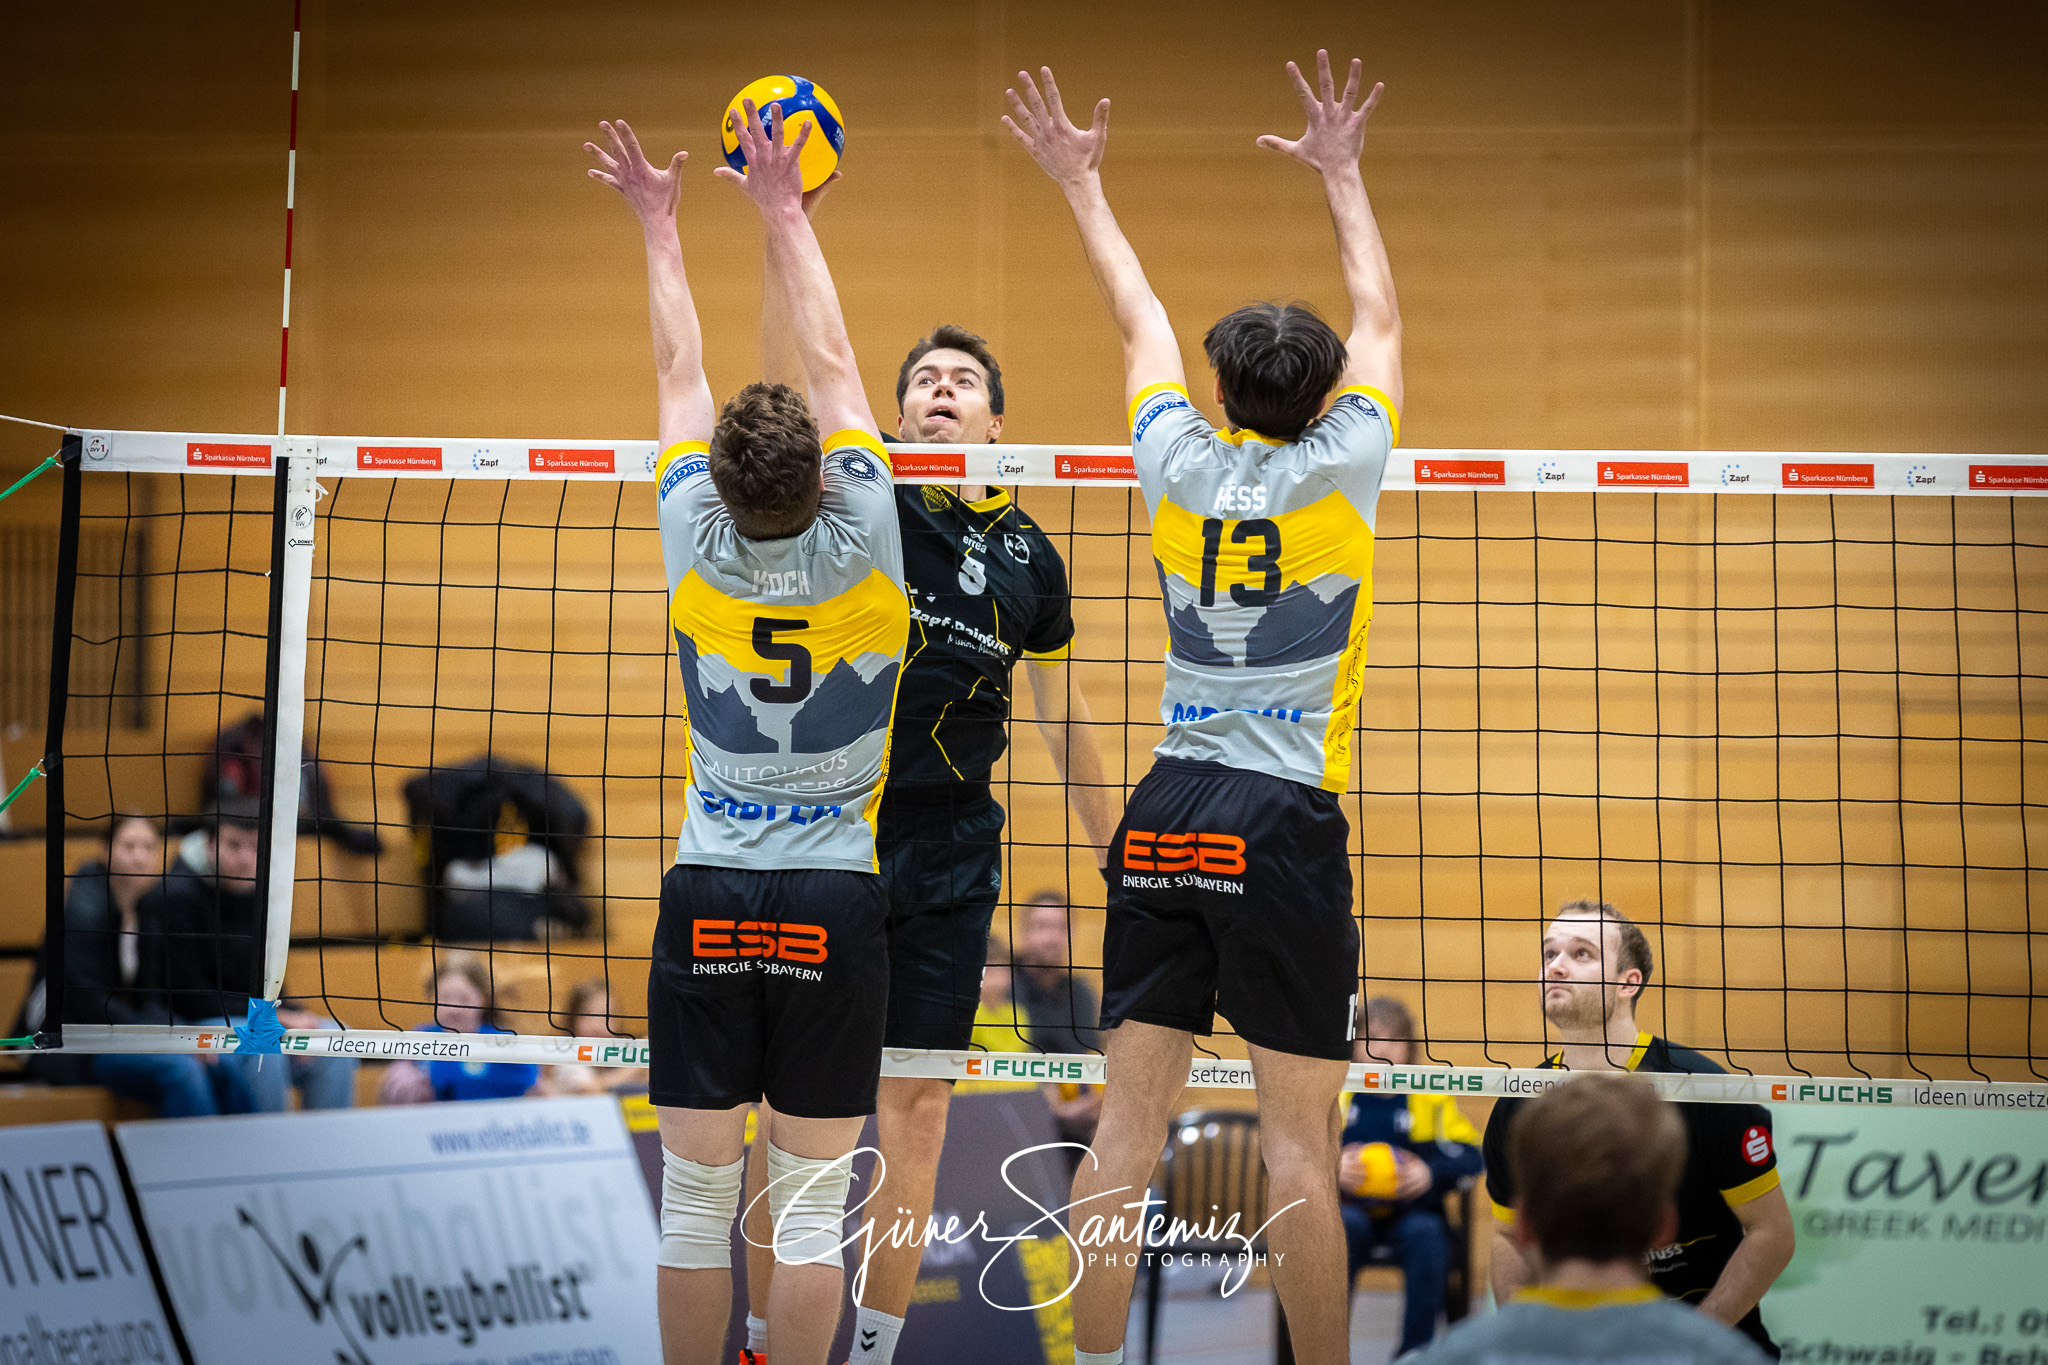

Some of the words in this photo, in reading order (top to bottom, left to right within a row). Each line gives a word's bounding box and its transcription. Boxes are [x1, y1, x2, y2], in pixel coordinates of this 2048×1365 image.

[205, 453, 236, 462] Sparkasse
[237, 454, 266, 464] Nürnberg
[316, 457, 328, 465] apf
[375, 457, 406, 466] Sparkasse
[407, 457, 436, 466] Nürnberg
[480, 458, 499, 467] Zapf
[547, 459, 578, 468] Sparkasse
[579, 460, 609, 469] Nürnberg
[896, 463, 928, 473] Sparkasse
[929, 463, 960, 473] Nürnberg
[1004, 465, 1024, 474] Zapf
[1073, 466, 1106, 475] Sparkasse
[1433, 470, 1467, 480] Sparkasse
[1468, 470, 1499, 480] Nürnberg
[1545, 472, 1566, 482] Zapf
[1616, 472, 1650, 482] Sparkasse
[1651, 472, 1683, 483] Nürnberg
[1729, 474, 1750, 483] Zapf
[1801, 474, 1835, 483] Sparkasse
[1836, 474, 1868, 484] Nürnberg
[1916, 475, 1936, 485] Zapf
[1988, 475, 2022, 485] Sparkasse
[1213, 485, 1267, 511] HESS
[1200, 518, 1283, 608] 13
[752, 569, 811, 596] KOCH
[750, 617, 812, 703] 5
[1123, 830, 1247, 875] ESB
[1122, 874, 1172, 888] ENERGIE
[693, 919, 828, 964] ESB
[692, 961, 752, 975] ENERGIE
[327, 1038, 377, 1054] Ideen
[382, 1041, 470, 1058] umsetzen
[993, 1060, 1083, 1079] FUCHS
[1190, 1064, 1251, 1085] setzen
[1391, 1072, 1483, 1092] FUCHS
[1503, 1075, 1555, 1094] Ideen
[1798, 1084, 1893, 1104] FUCHS
[1914, 1087, 1967, 1106] Ideen
[0, 1163, 135, 1288] NER
